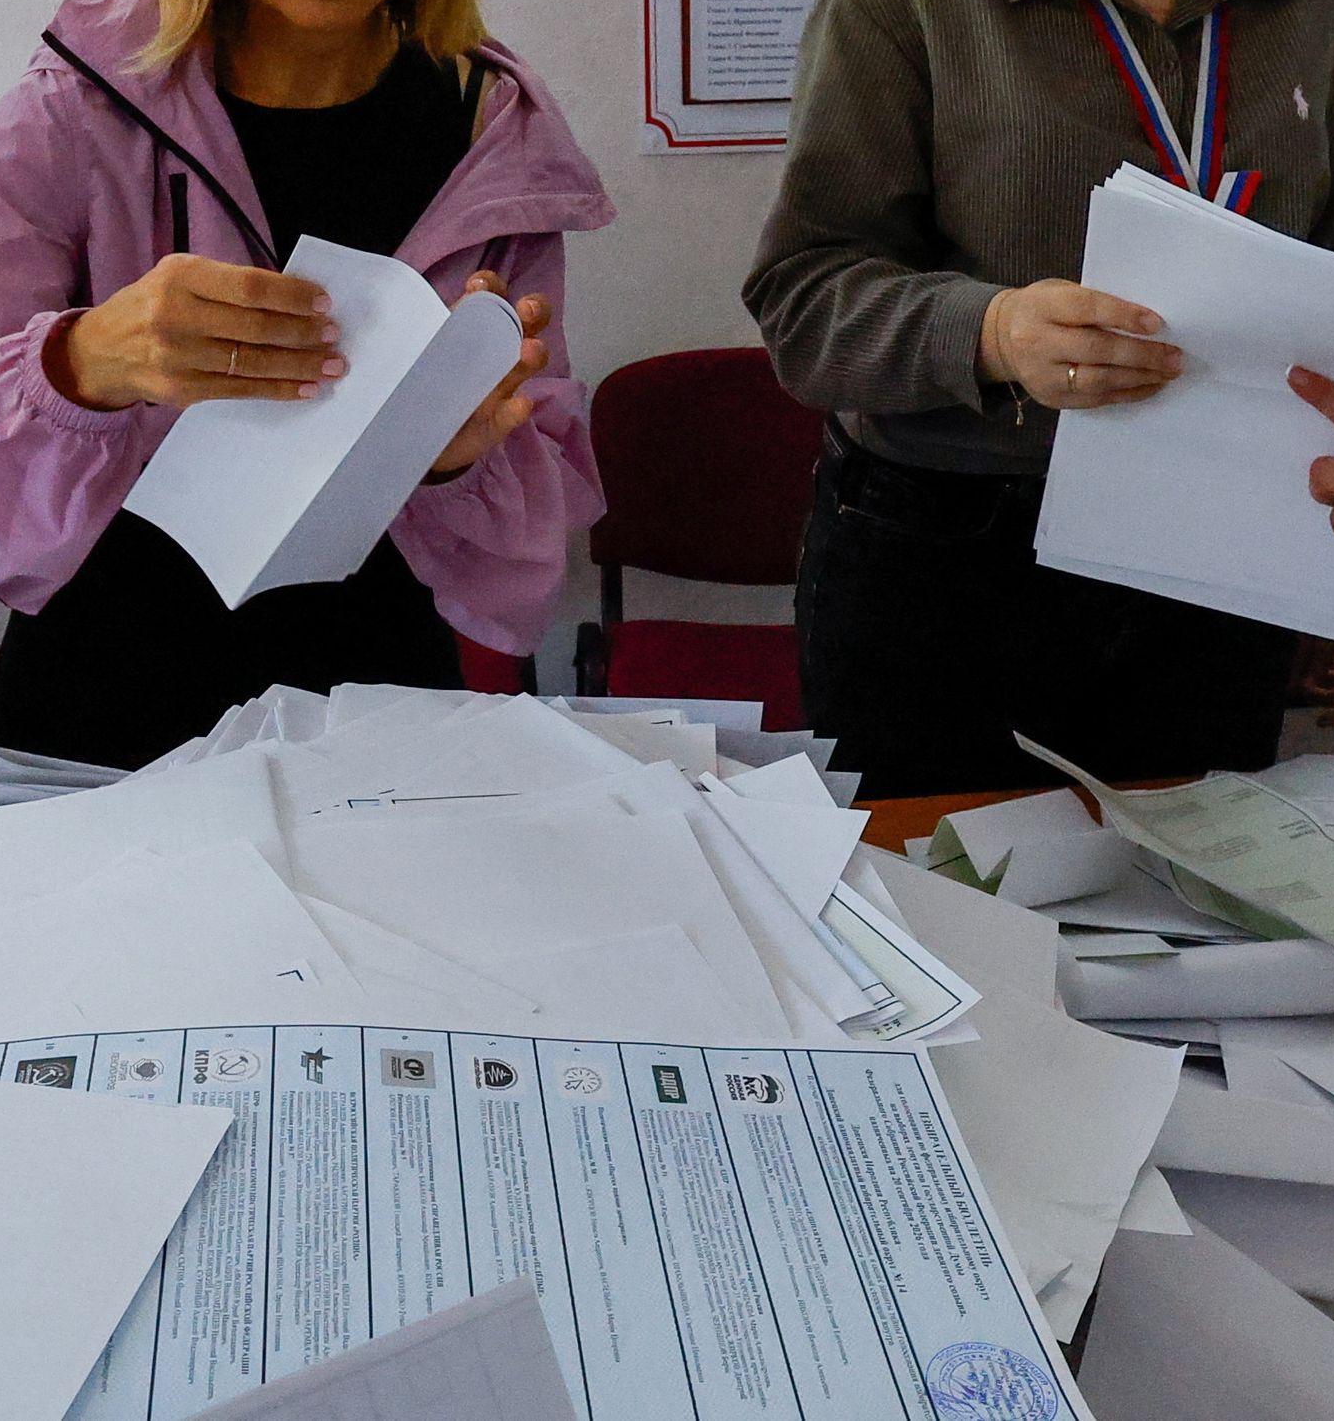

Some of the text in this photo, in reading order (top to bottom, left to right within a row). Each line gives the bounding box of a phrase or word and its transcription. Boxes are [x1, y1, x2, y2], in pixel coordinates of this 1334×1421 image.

[193, 1049, 210, 1085] КПРФ
[725, 1073, 739, 1101] РОССИЯ
[733, 1074, 747, 1101] ЕДИНАЯ
[917, 1112, 993, 1267] ИЗБИРАТЕЛЬНЫЙ БЮЛЛЕТЕНЬ
